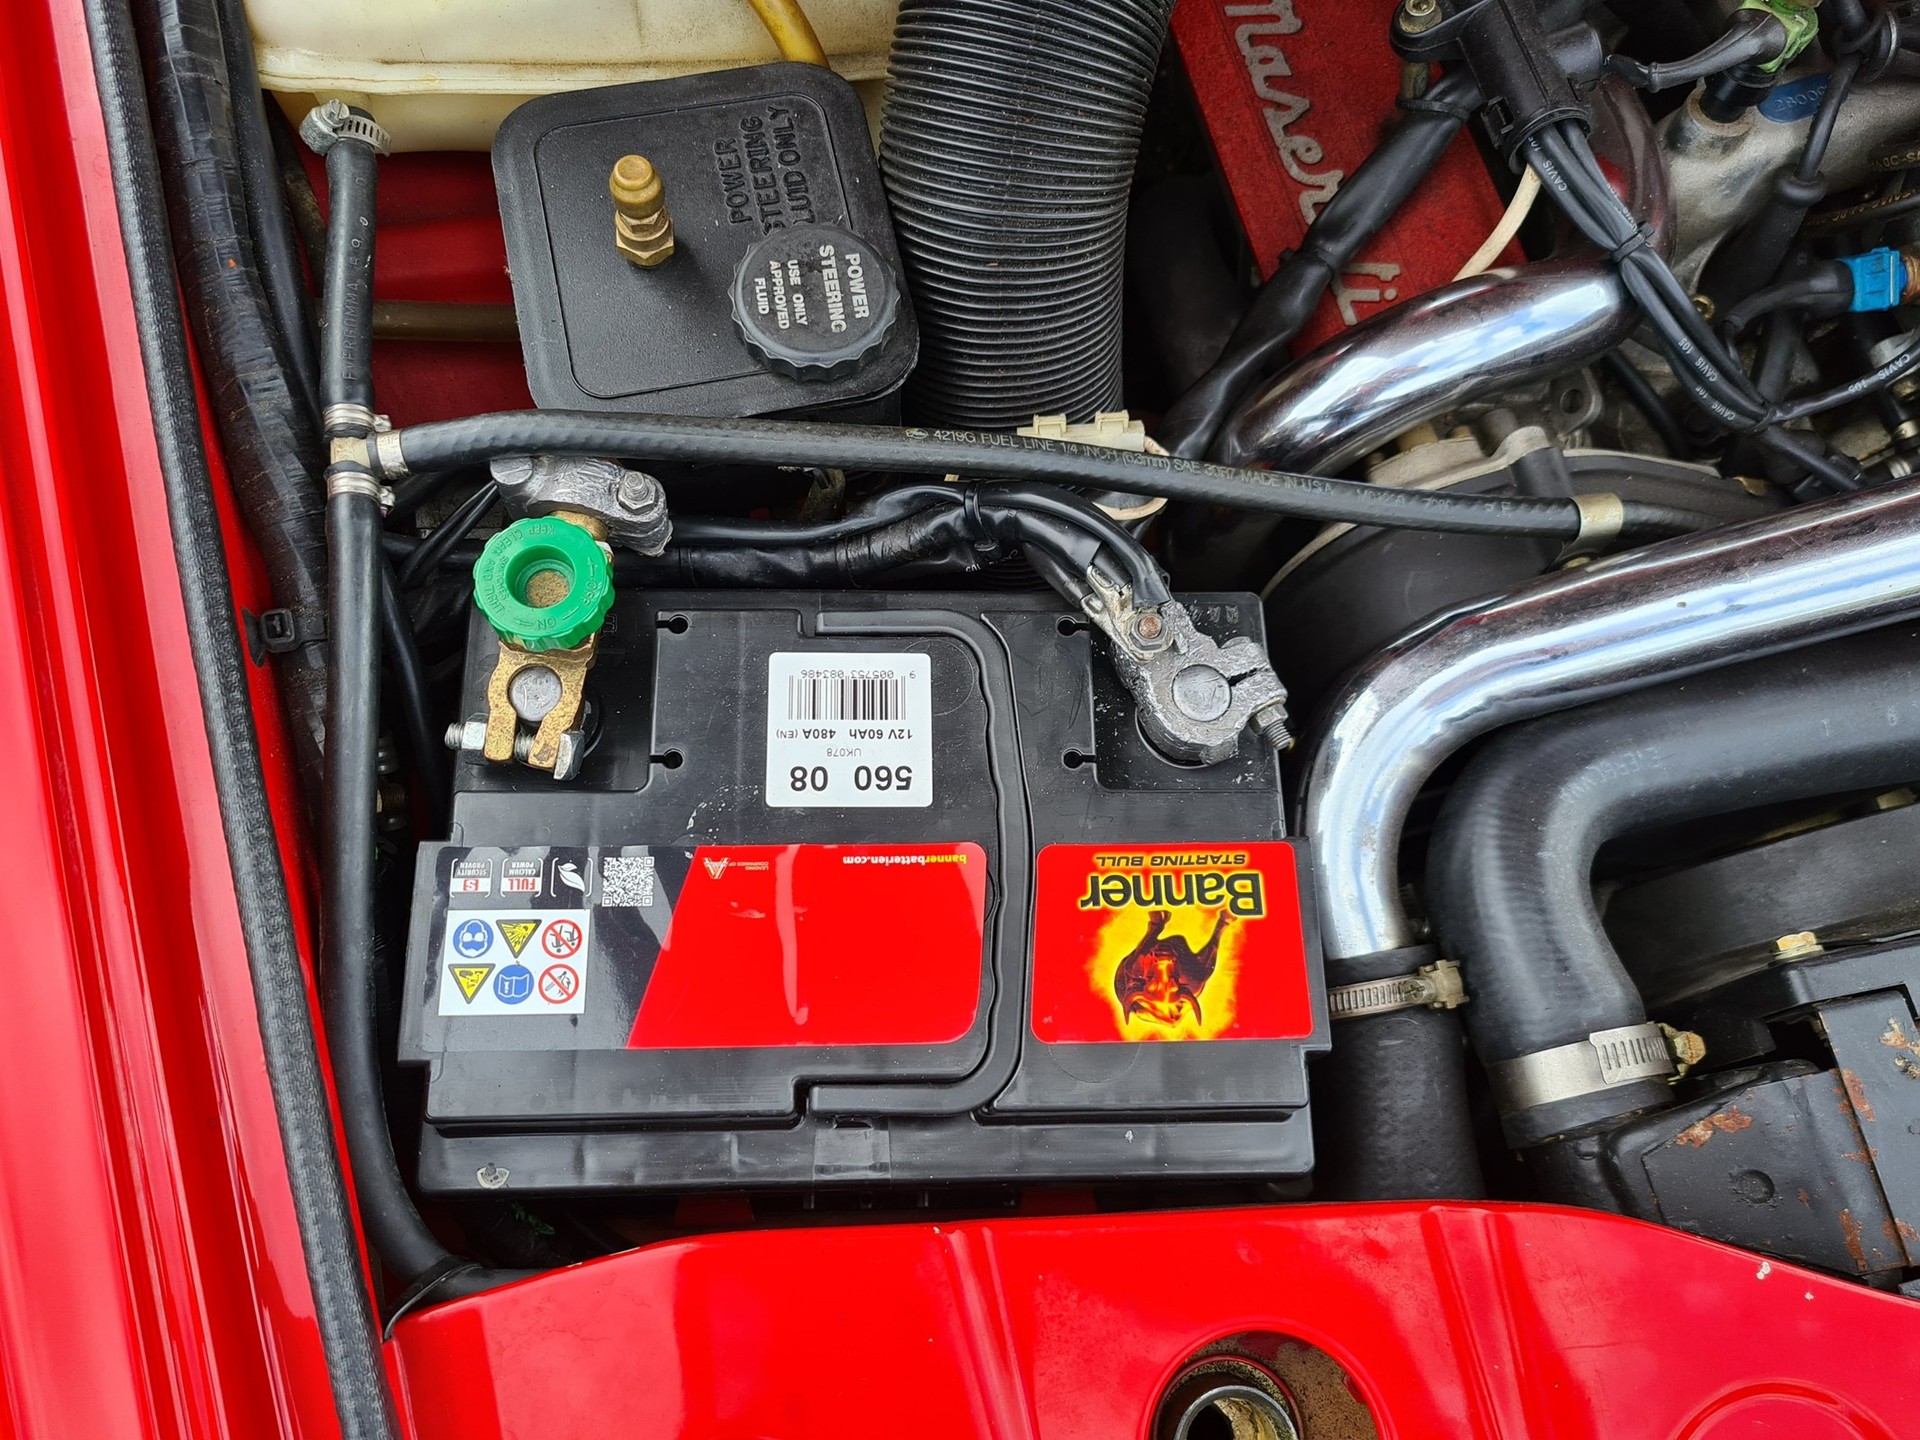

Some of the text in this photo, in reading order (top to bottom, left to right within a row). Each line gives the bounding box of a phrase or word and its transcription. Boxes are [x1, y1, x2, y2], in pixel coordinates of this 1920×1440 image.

[713, 137, 753, 225] POWER
[738, 116, 785, 237] STEERING
[766, 105, 816, 226] LUID ONLY
[1224, 0, 1402, 326] Maserti
[1542, 159, 1568, 192] CAVIS
[754, 277, 771, 315] FLUID
[770, 260, 791, 330] APPROVED
[788, 259, 809, 326] USE ONLY
[819, 243, 848, 334] STEERING
[845, 253, 871, 319] POWER
[1677, 337, 1718, 382] 105 CAVIS
[1848, 353, 1911, 393] CAVIS 105
[1711, 401, 1736, 421] CAVIS
[932, 430, 976, 444] 4219G
[980, 433, 1019, 448] FUEL
[1023, 438, 1056, 452] LINE
[1060, 441, 1078, 455] 1/4
[1083, 445, 1117, 460] INCH
[1173, 459, 1201, 475] SAE
[1241, 469, 1280, 488] MADE
[1283, 476, 1298, 491] IN
[536, 616, 557, 630] ON
[800, 669, 916, 679] 9 005753 083486
[776, 728, 913, 739] 12V 60Ah 480A (EN)
[826, 747, 862, 757] UK078
[790, 765, 913, 792] 560 08
[457, 868, 487, 876] SECURITY
[508, 868, 536, 876] CALCIUM
[843, 853, 967, 866] bannerbatterien.com
[1096, 853, 1246, 867] STARTING BULL
[507, 878, 536, 891] FULL
[1080, 873, 1264, 916] Banner
